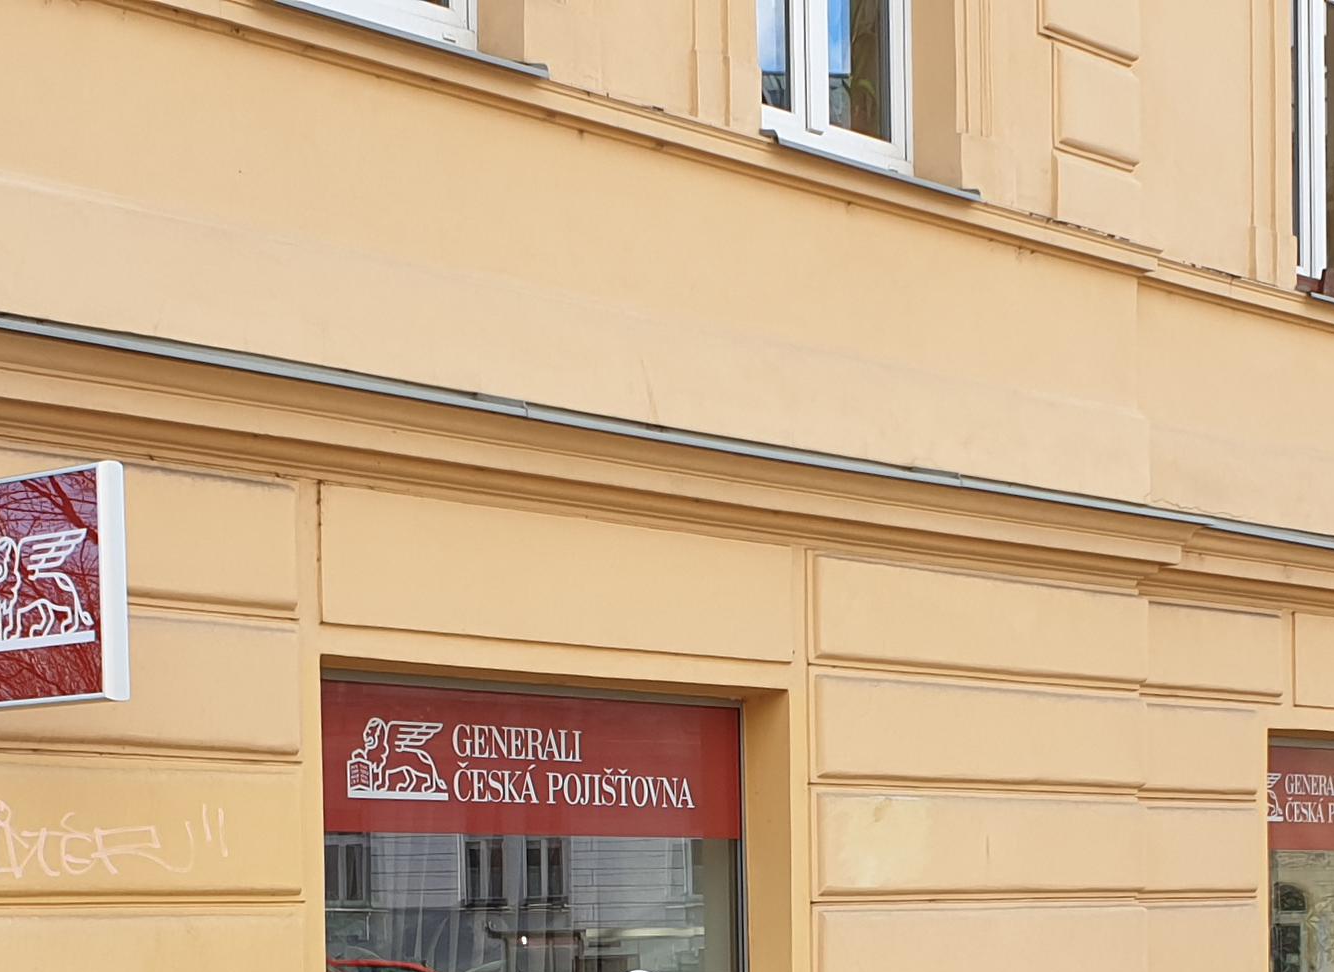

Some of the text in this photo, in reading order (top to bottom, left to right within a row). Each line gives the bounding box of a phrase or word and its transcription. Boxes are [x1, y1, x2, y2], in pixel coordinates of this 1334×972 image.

[452, 724, 582, 762] GENERALI
[453, 762, 696, 809] ČESKÁ POJIŠŤOVNA
[1285, 798, 1325, 823] ČESKÁ
